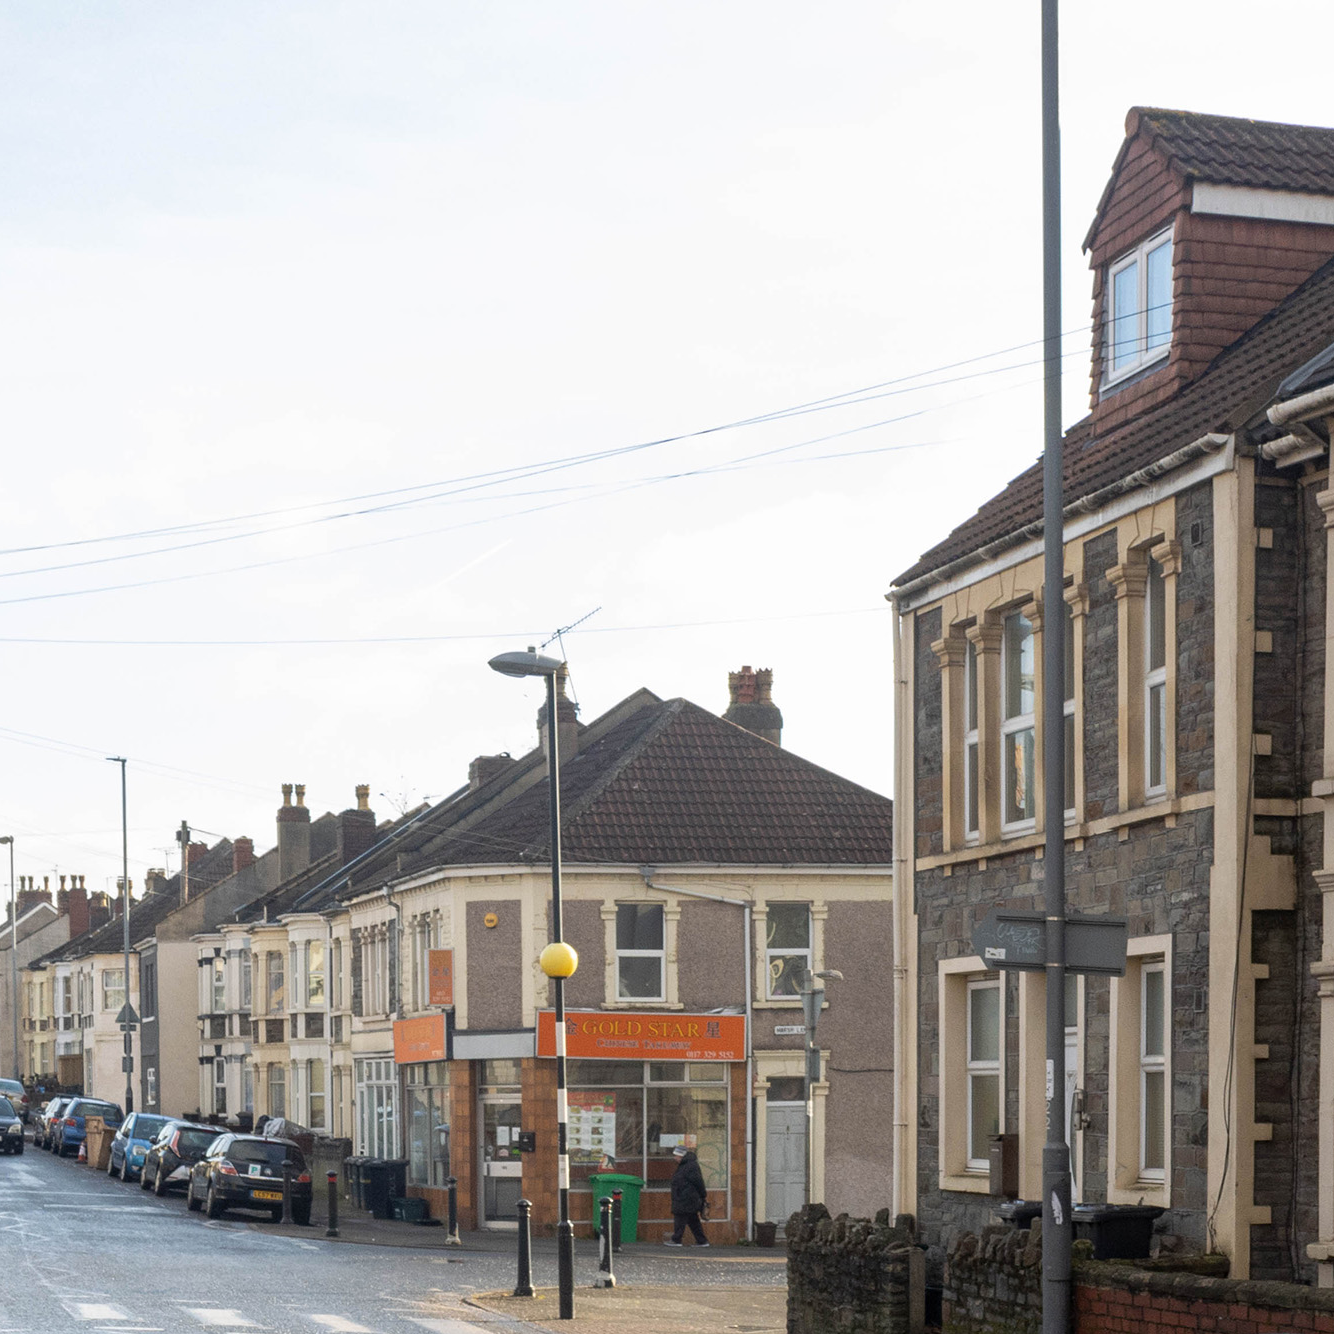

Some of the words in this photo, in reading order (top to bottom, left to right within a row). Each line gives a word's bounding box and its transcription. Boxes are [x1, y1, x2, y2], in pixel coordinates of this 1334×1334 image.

[582, 1019, 642, 1036] GOLD
[648, 1022, 701, 1038] STAR
[596, 1038, 639, 1049] CHINESE
[643, 1039, 692, 1050] TAKEAWAY
[686, 1051, 701, 1059] 0117
[703, 1051, 716, 1059] 329
[718, 1052, 735, 1060] 5152
